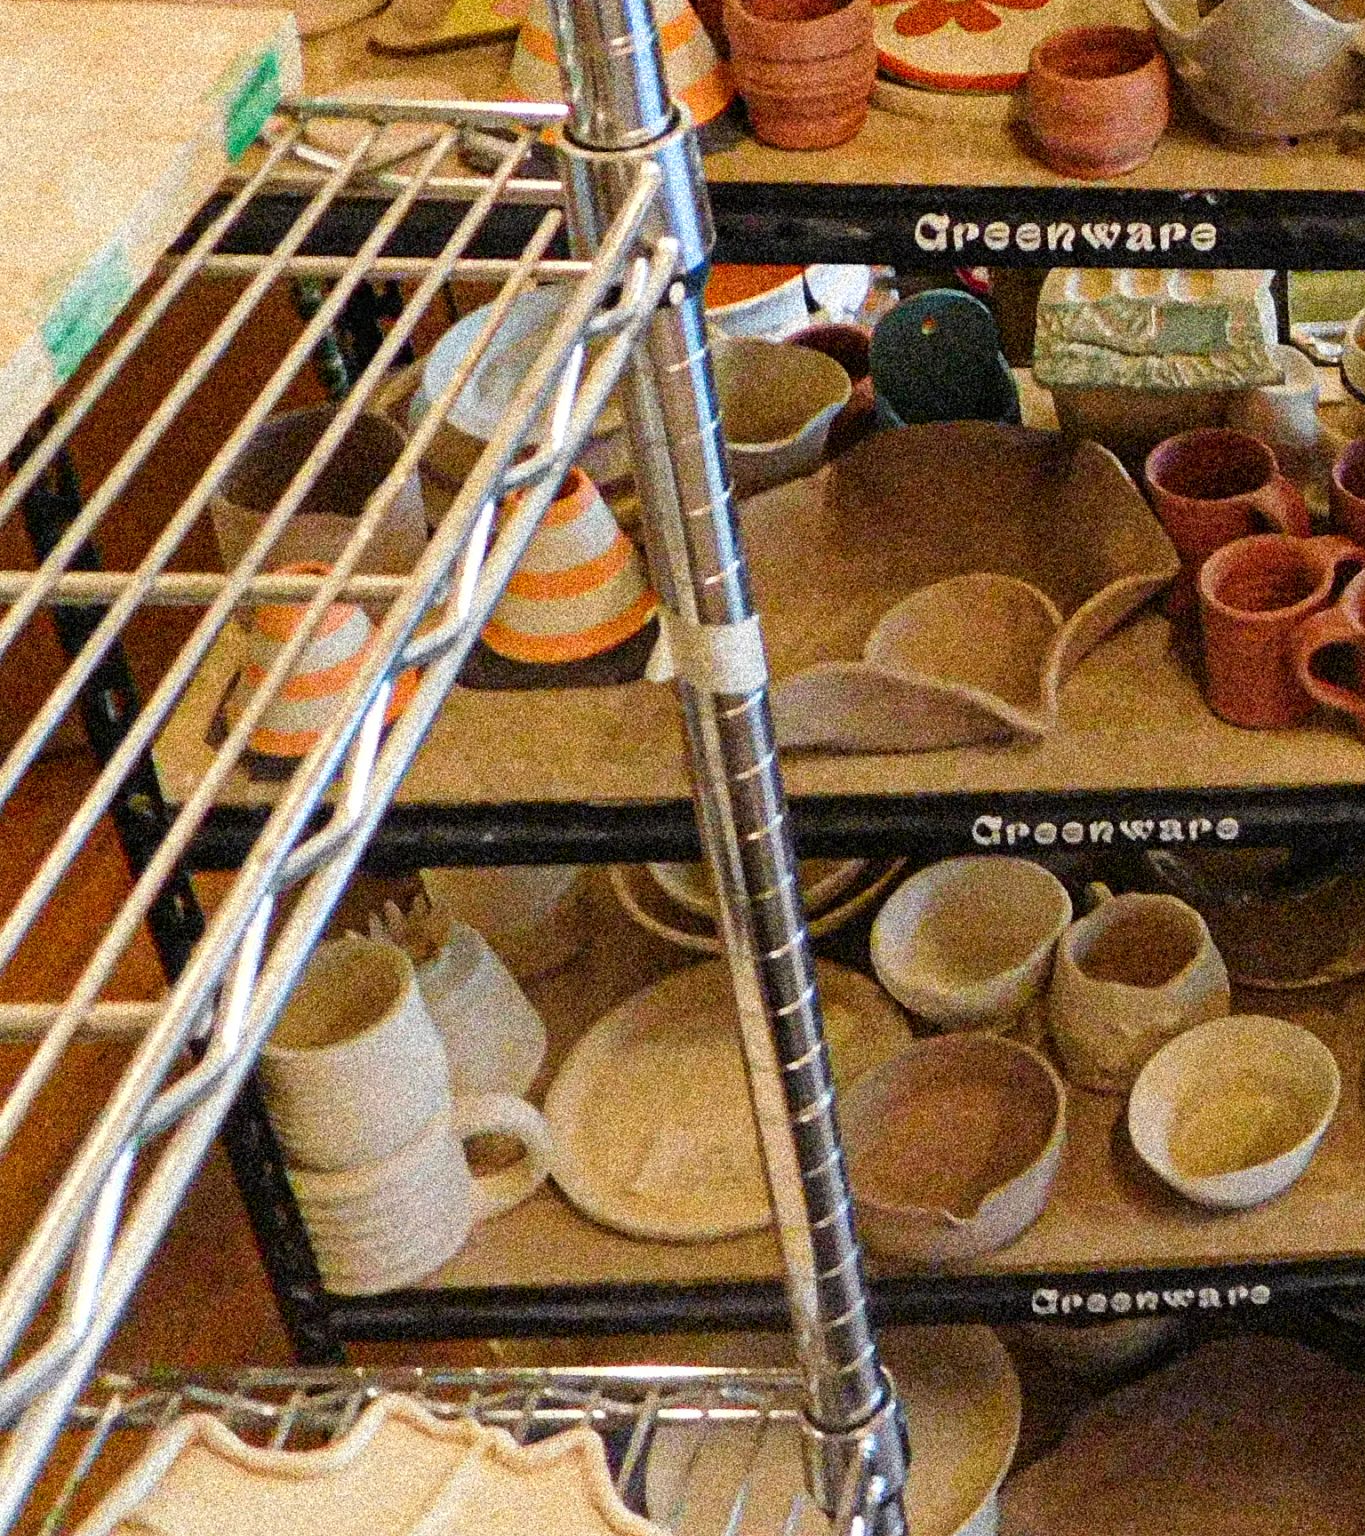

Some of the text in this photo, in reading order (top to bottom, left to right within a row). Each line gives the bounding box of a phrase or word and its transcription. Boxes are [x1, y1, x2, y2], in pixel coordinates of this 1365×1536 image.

[914, 213, 1218, 252] Greenware
[972, 814, 1240, 845] Greenware
[1031, 1283, 1271, 1315] Greenware
